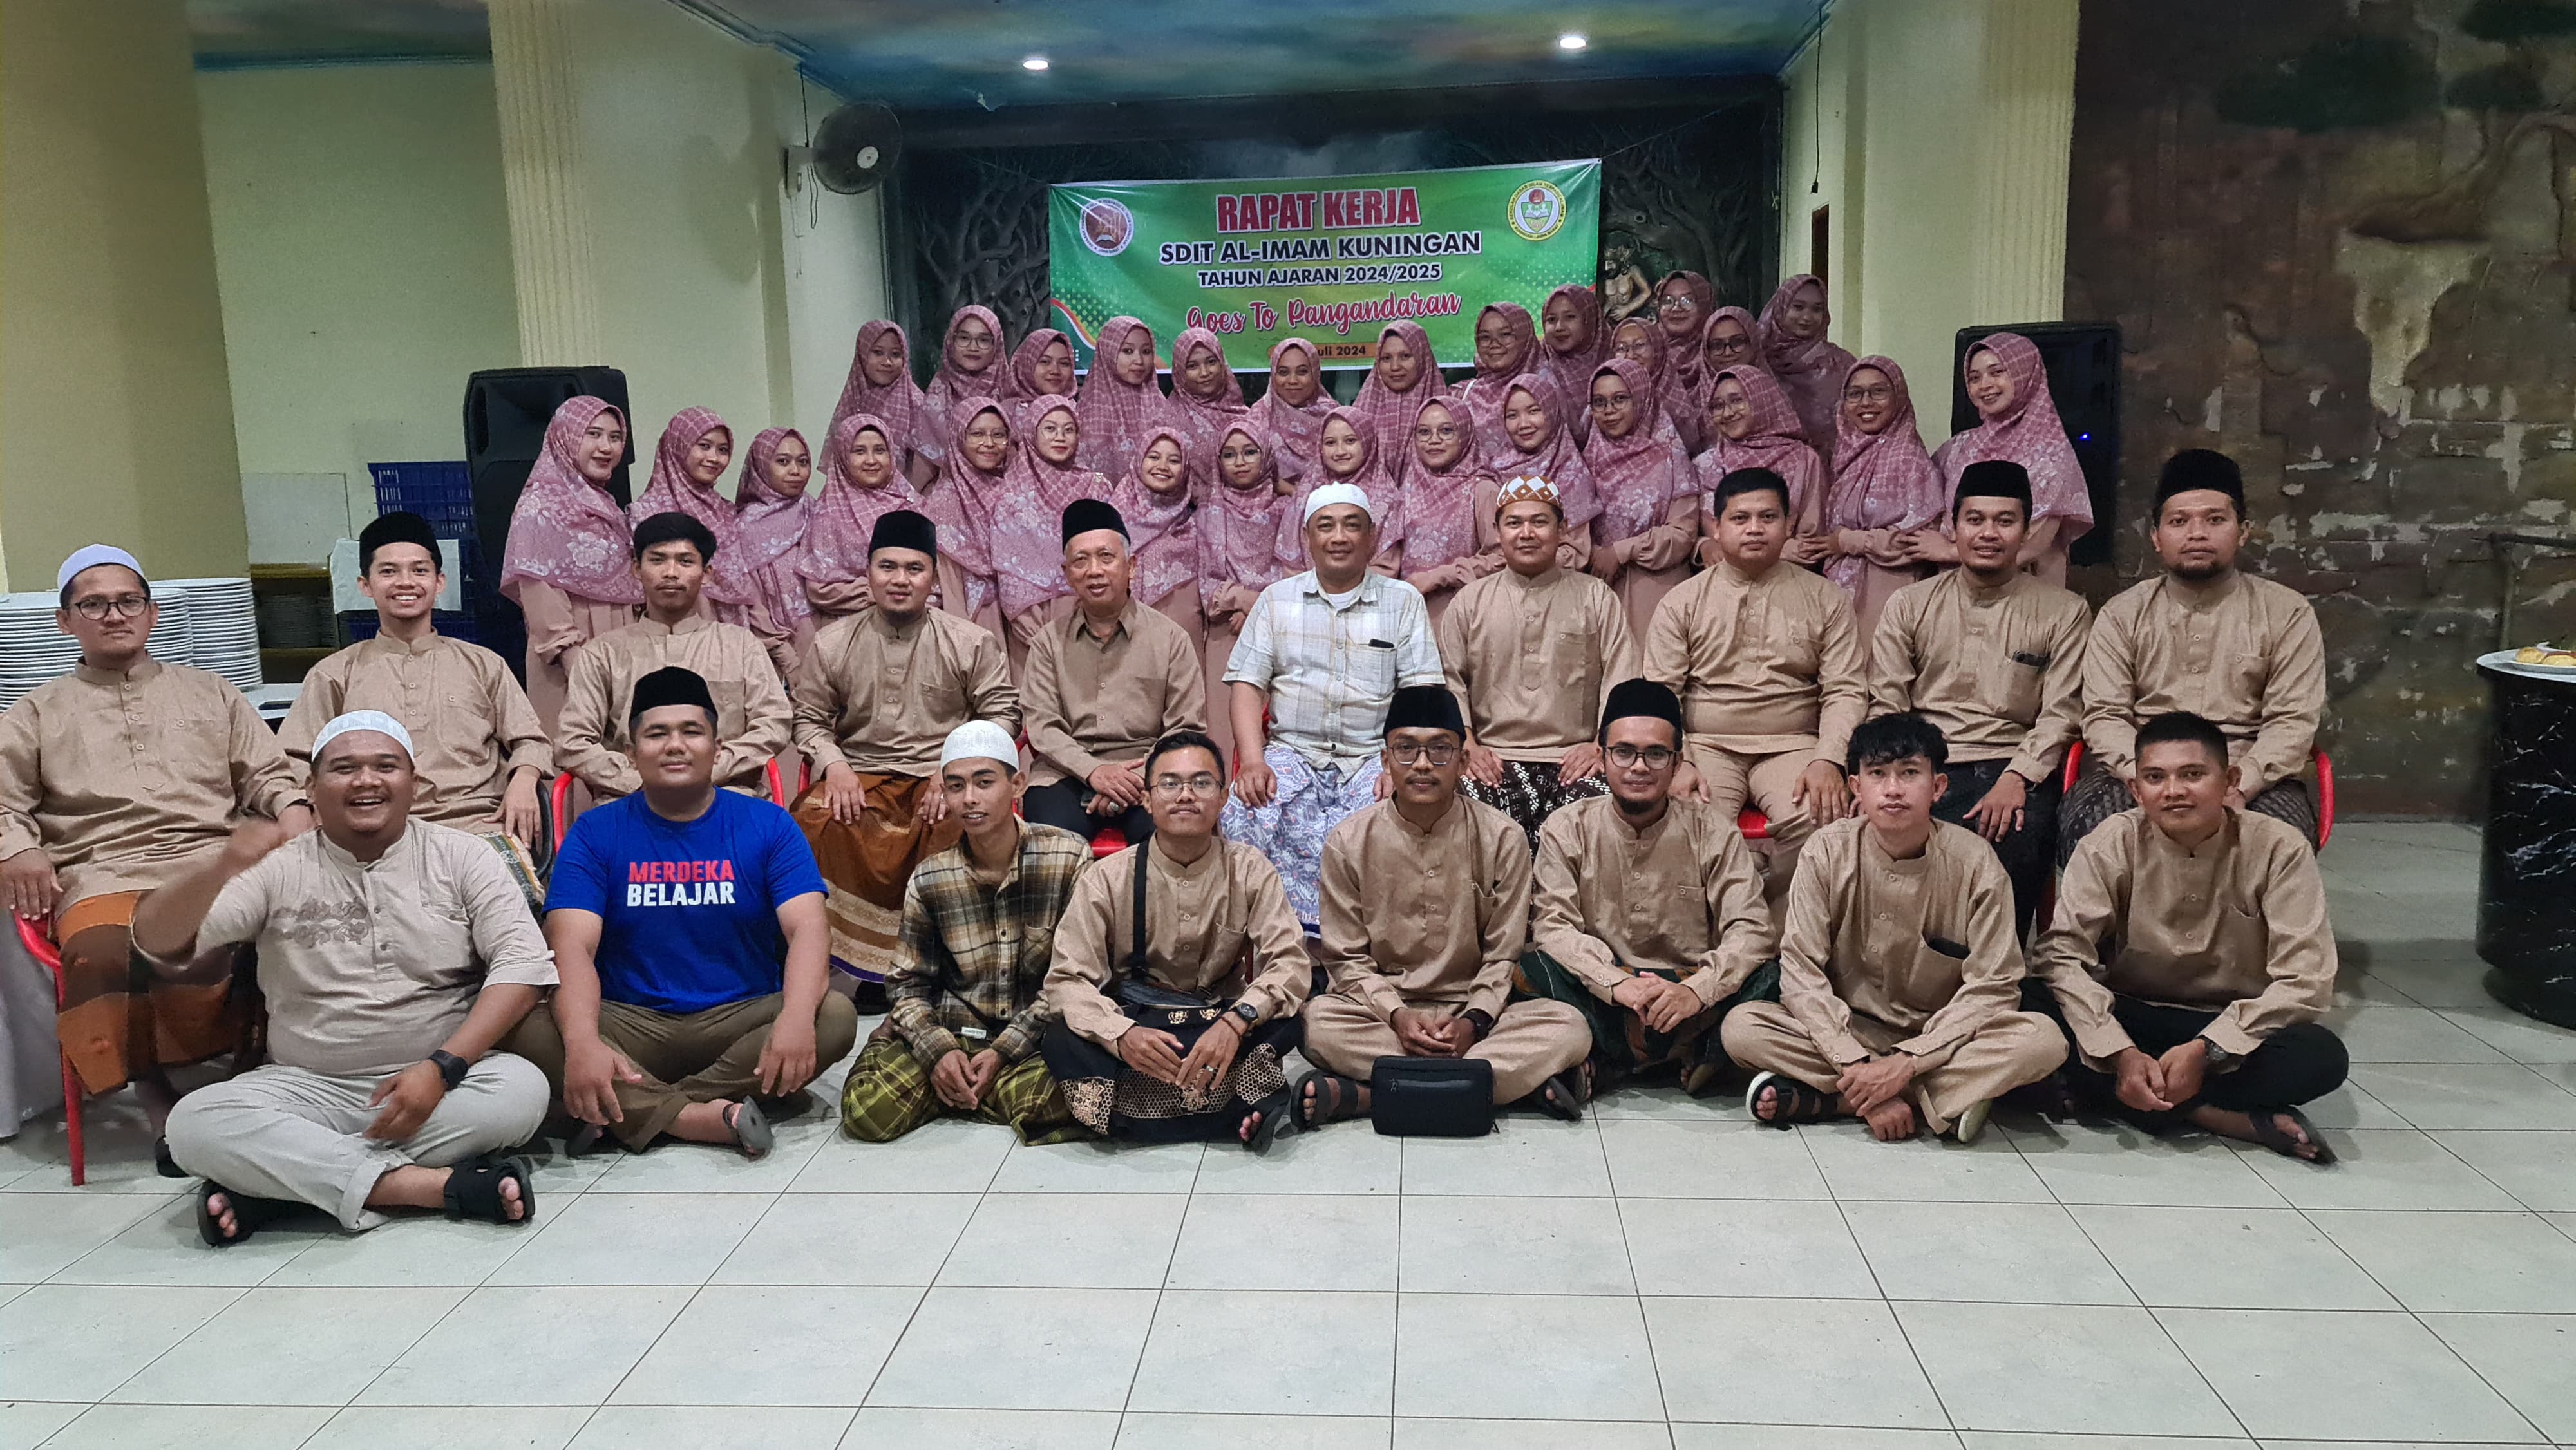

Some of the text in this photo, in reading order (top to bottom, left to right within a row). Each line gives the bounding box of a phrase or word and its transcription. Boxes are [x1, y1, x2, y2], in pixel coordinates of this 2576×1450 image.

[1217, 187, 1421, 232] RAPAT KERJA
[1160, 231, 1482, 265] SDIT AL-IMAM KUNINGAN
[1198, 262, 1442, 288] TAHUN AJARAN 2024/2025
[1249, 300, 1278, 330] To
[1287, 290, 1461, 335] Pangandaran
[1317, 344, 1366, 356] uli 2024
[629, 860, 735, 883] MERDEKA
[627, 881, 736, 907] BELAJAR
